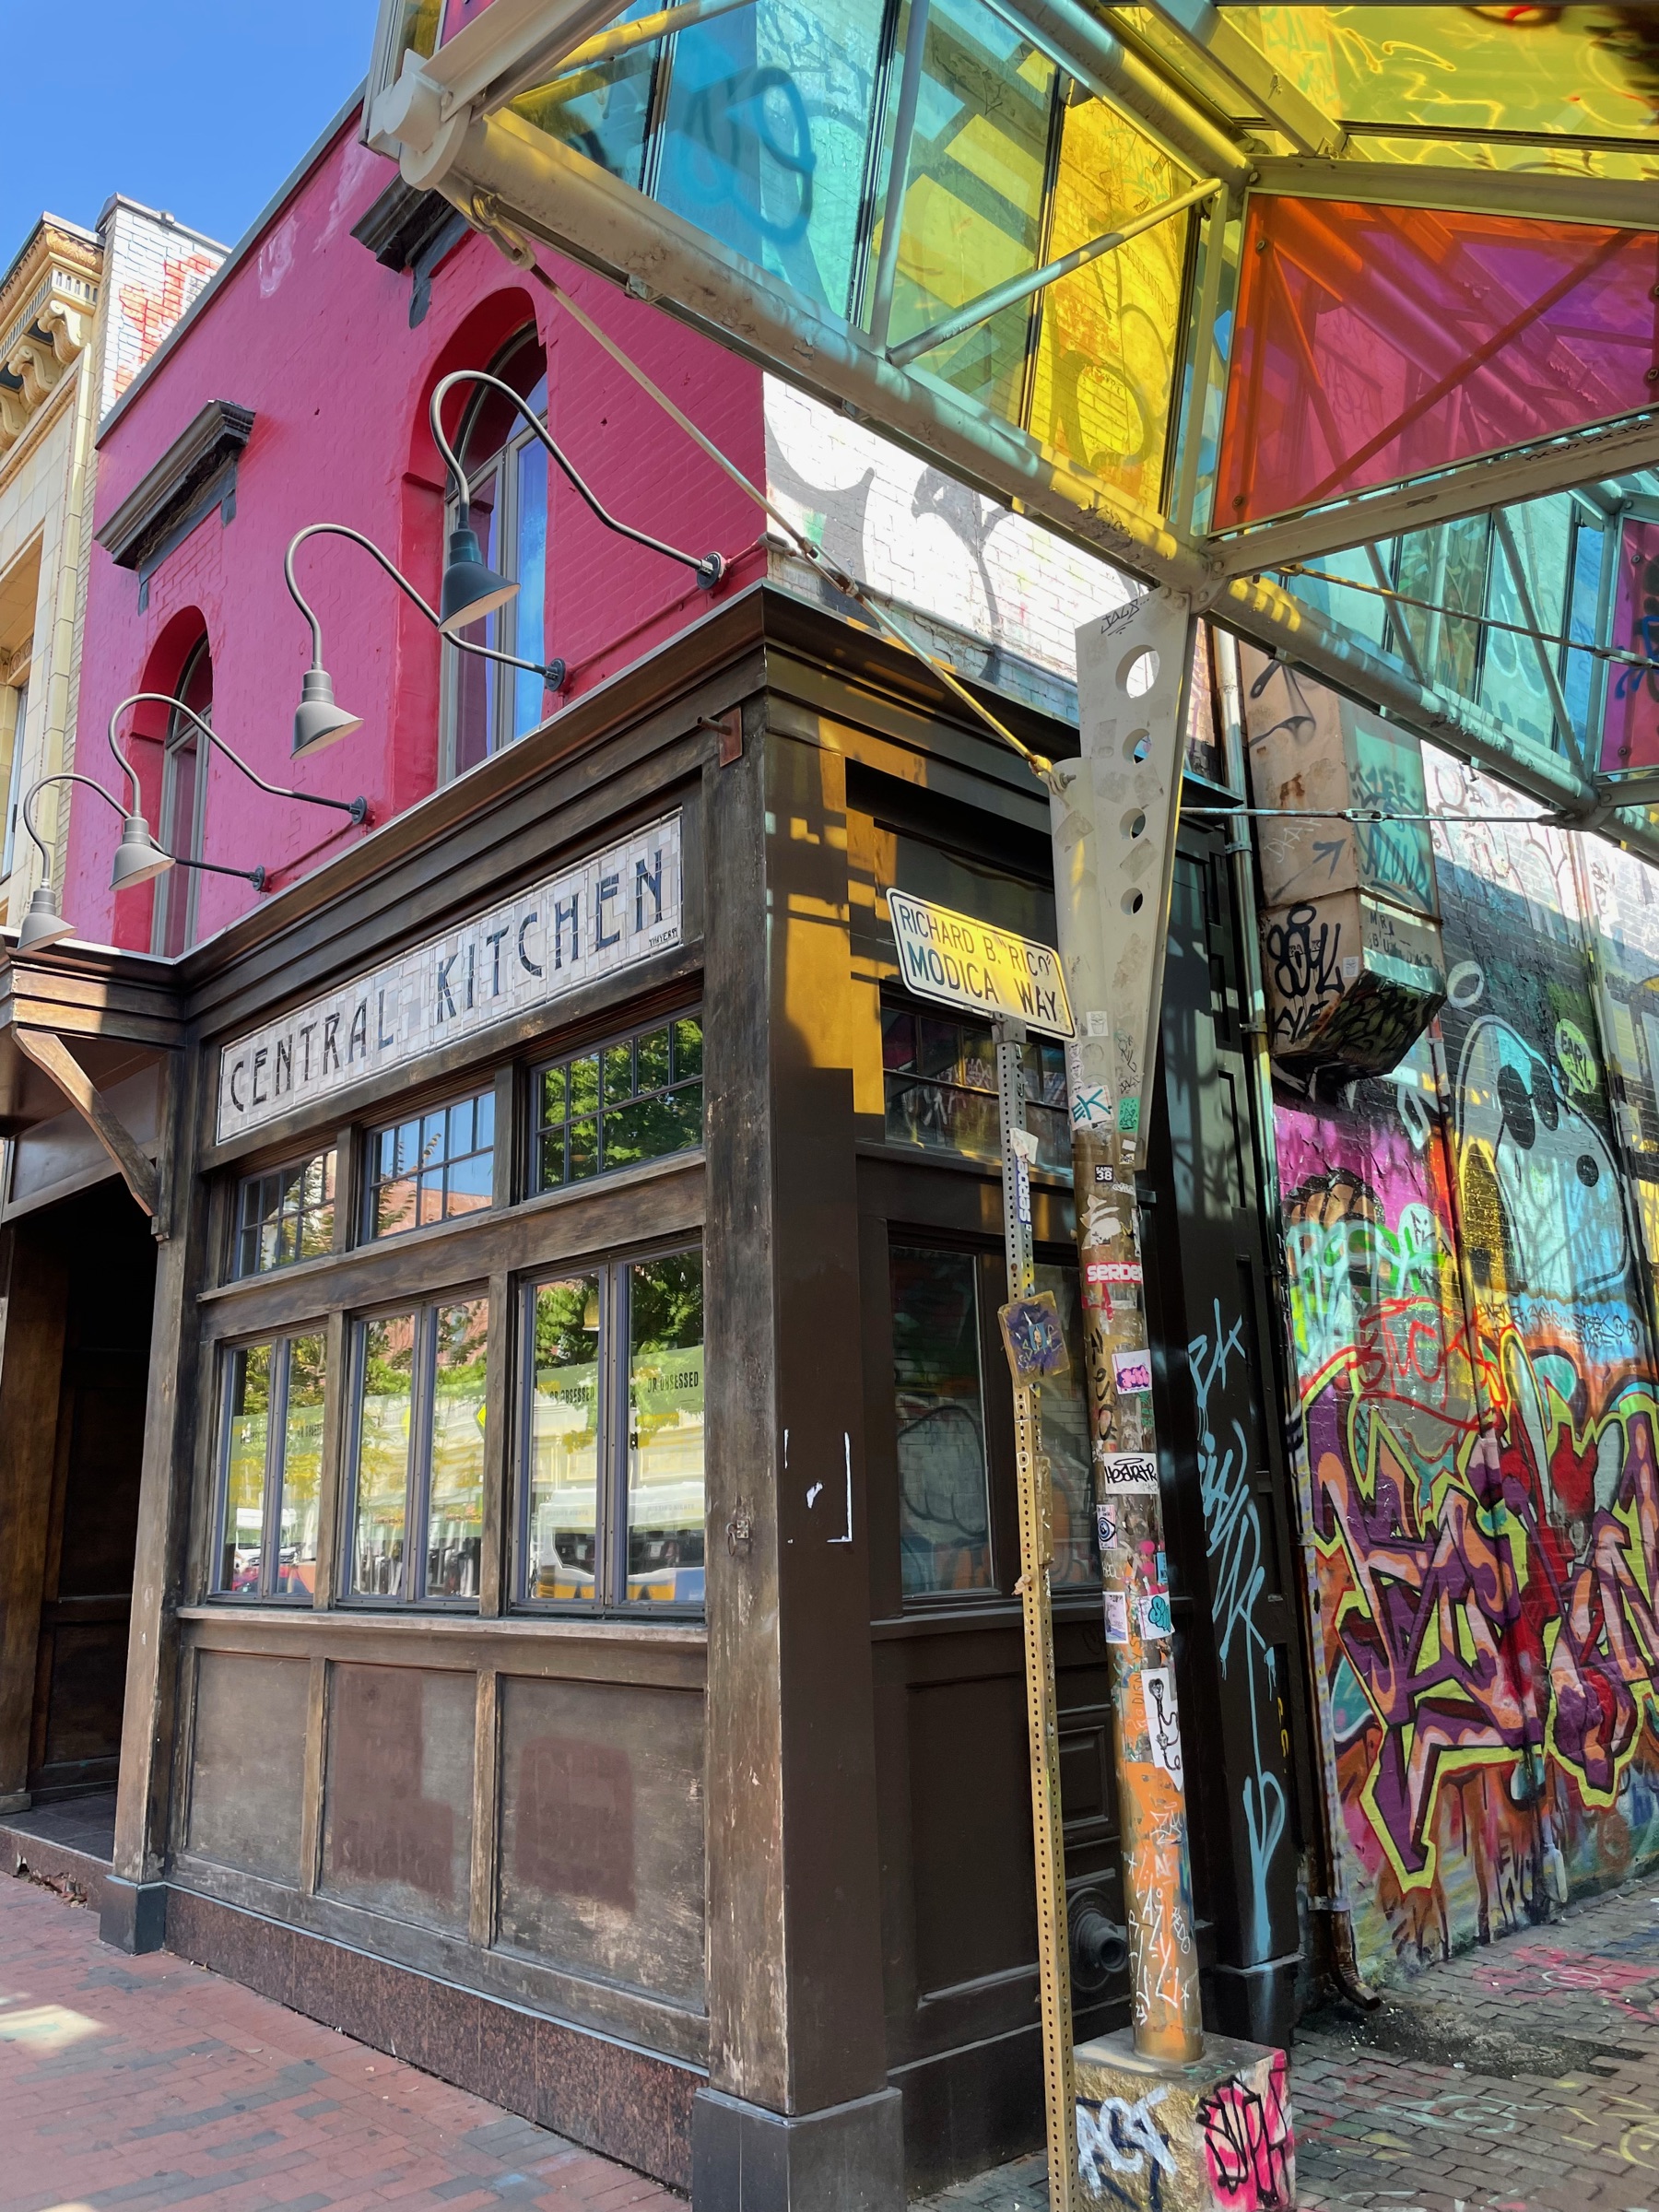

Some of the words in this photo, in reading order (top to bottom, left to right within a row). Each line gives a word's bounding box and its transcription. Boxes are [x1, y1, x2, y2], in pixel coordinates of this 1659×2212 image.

[899, 903, 974, 954] RICHARD
[982, 935, 1002, 965] B.
[230, 989, 394, 1112] CENTRAL
[435, 850, 664, 1023] KITCHEN
[907, 941, 999, 1004] MODICA
[1013, 978, 1058, 1022] WAY
[1096, 1171, 1112, 1181] 38
[659, 1371, 700, 1391] OBSESSED
